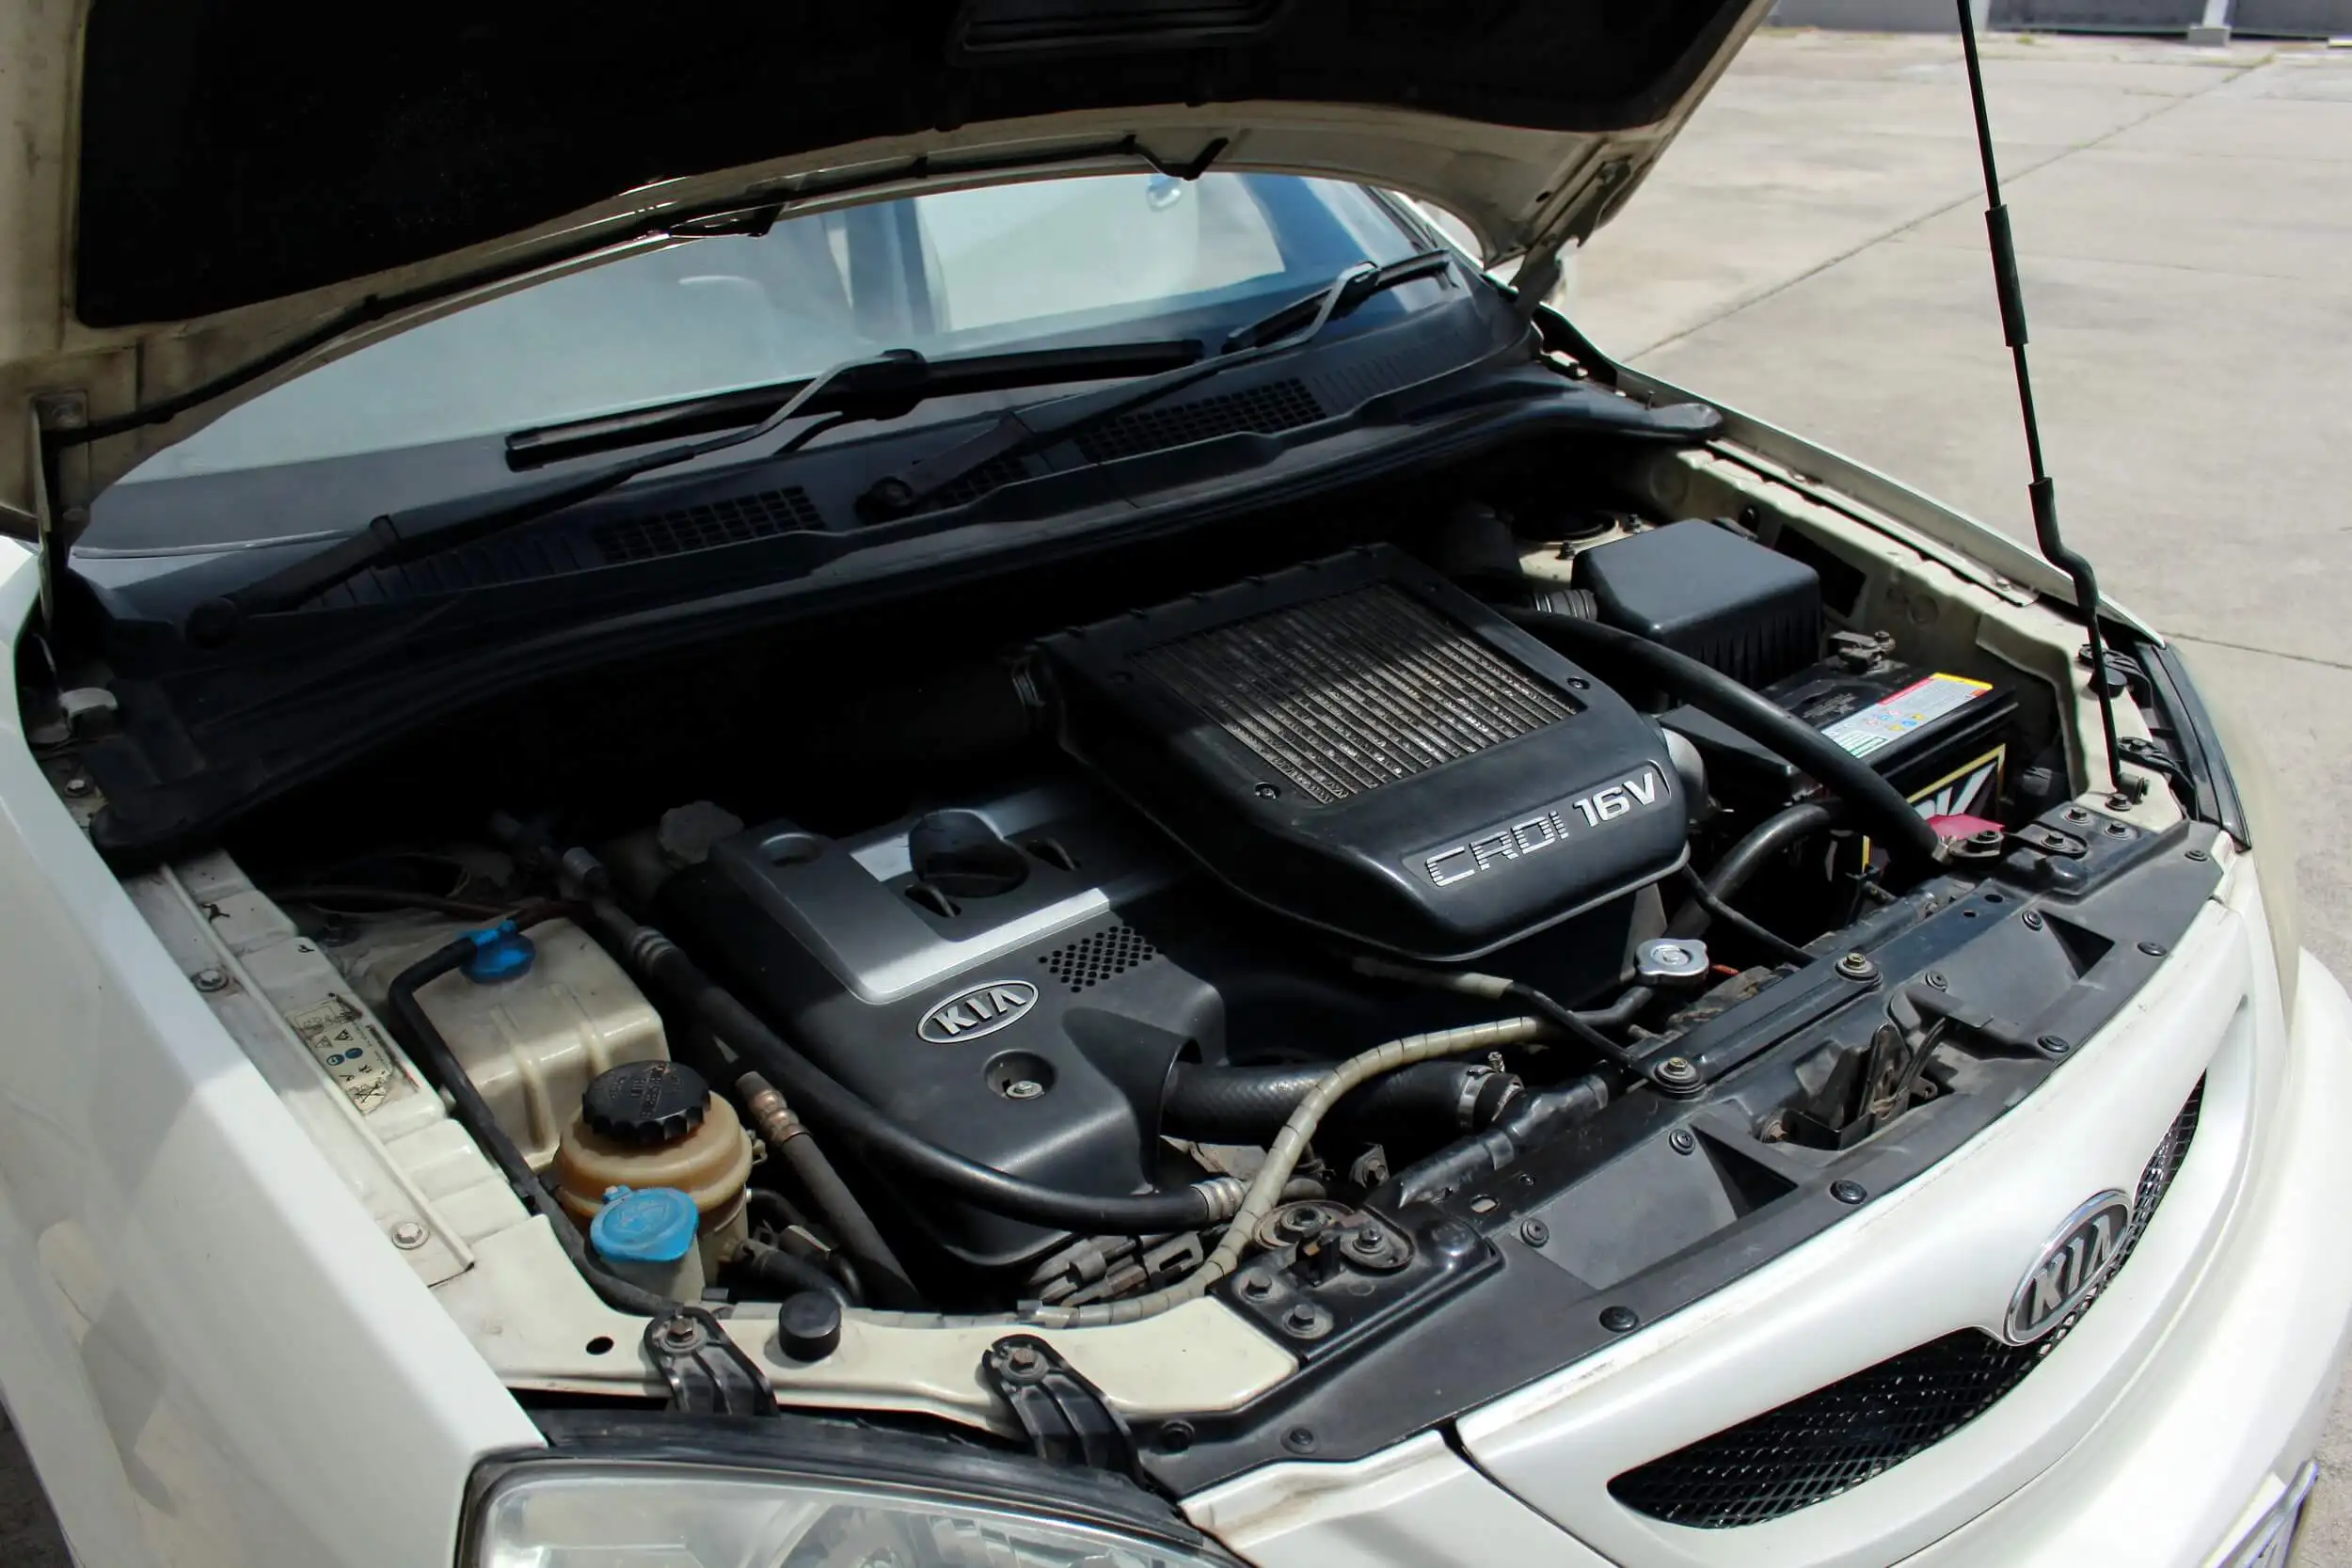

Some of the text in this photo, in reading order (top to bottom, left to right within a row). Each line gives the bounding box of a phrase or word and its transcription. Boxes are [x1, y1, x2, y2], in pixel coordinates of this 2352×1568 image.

[1572, 771, 1656, 829] 16V
[933, 988, 1027, 1037] KIA
[2027, 1213, 2112, 1325] KIA
